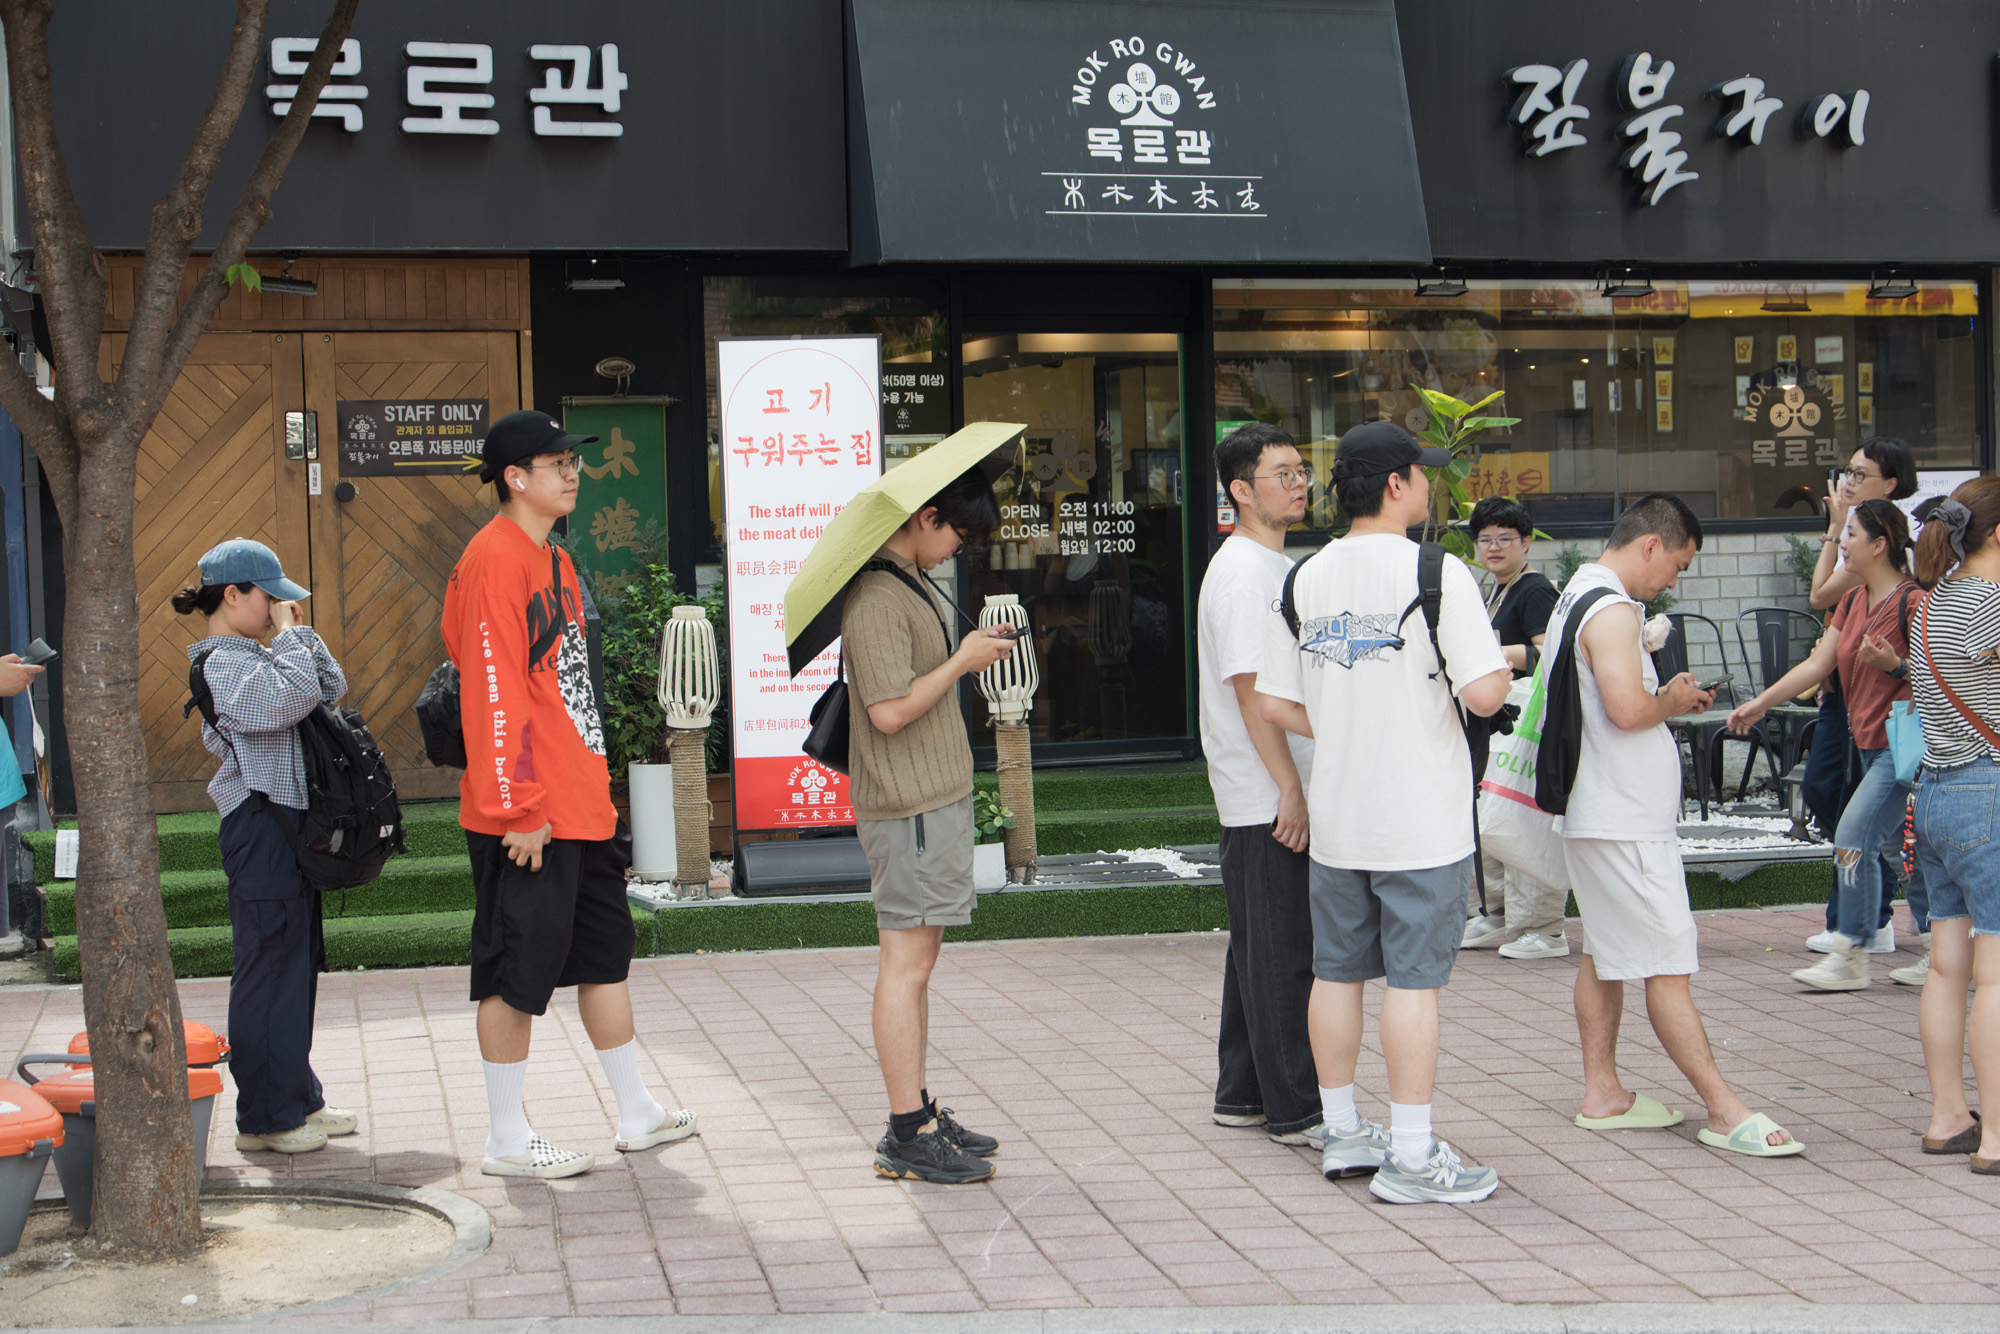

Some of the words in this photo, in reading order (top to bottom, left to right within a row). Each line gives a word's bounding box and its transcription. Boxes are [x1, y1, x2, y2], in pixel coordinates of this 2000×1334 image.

[1072, 50, 1109, 105] MOK
[1109, 36, 1145, 59] RO
[1156, 43, 1217, 109] GWAN
[265, 37, 629, 137] 목로관
[1512, 51, 1870, 206] 짚불구이
[1087, 127, 1212, 164] 목로관
[920, 375, 944, 386] 이상)
[904, 392, 924, 404] 가능
[1744, 377, 1772, 422] MOK
[1774, 363, 1799, 381] RO
[384, 405, 435, 422] STAFF
[442, 404, 483, 421] ONLY
[396, 425, 422, 435] 관계자
[426, 425, 435, 435] 외
[438, 424, 473, 435] 출입금지
[389, 440, 424, 455] 오른쪽
[732, 432, 841, 469] 구워주는
[850, 430, 872, 466] 집
[1752, 438, 1840, 467] 목로관
[748, 505, 771, 519] The
[775, 504, 806, 518] staff
[809, 503, 831, 516] will
[1000, 504, 1040, 519] OPEN
[1059, 501, 1087, 517] 오전
[1093, 501, 1135, 515] 11:00
[738, 528, 760, 541] the
[763, 527, 797, 540] meat
[800, 526, 823, 539] deli
[1000, 524, 1049, 539] CLOSE
[1060, 521, 1088, 536] 새벽
[1093, 520, 1135, 535] 02:00
[1060, 540, 1089, 556] 월요일
[1094, 539, 1136, 553] 12:00
[750, 603, 772, 616] 매장
[762, 653, 786, 663] There
[822, 651, 830, 661] of
[749, 668, 758, 678] in
[760, 668, 774, 678] the
[799, 667, 821, 677] room
[823, 666, 831, 676] of
[486, 665, 499, 703] seen
[760, 683, 776, 693] and
[778, 684, 789, 692] on
[790, 683, 804, 692] the
[806, 683, 831, 692] secon
[493, 710, 507, 747] this
[787, 765, 802, 786] MOK
[803, 760, 816, 769] RO
[1496, 751, 1536, 779] OLIV
[495, 757, 512, 809] before
[791, 792, 837, 805] 목로관
